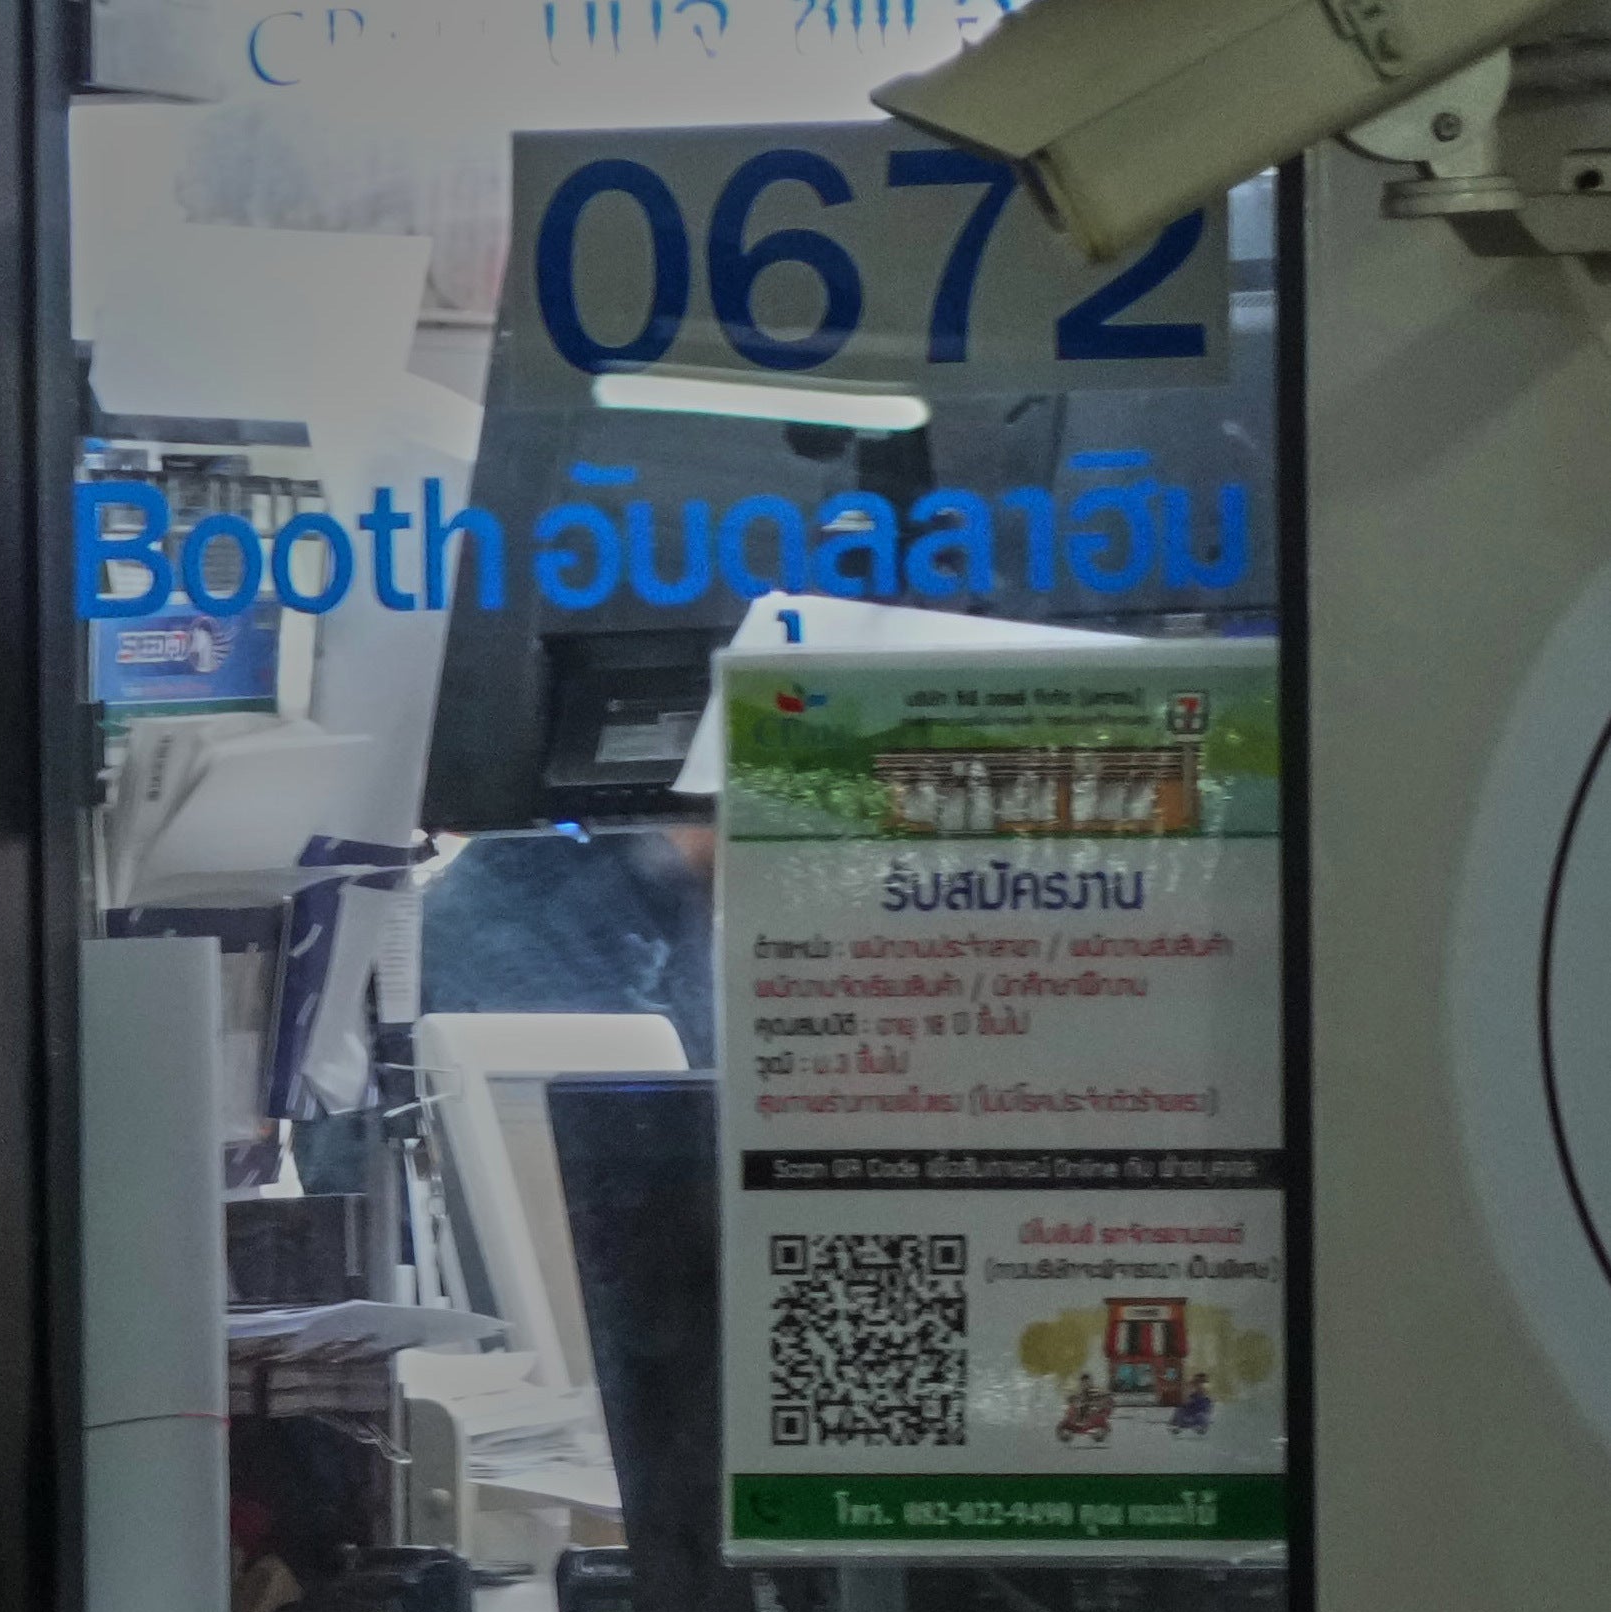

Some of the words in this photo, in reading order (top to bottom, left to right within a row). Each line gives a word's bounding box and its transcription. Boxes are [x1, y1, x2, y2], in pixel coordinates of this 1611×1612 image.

[533, 149, 1208, 375] 0672
[74, 477, 508, 620] Booth
[882, 859, 1143, 911] รับสมัครงาน
